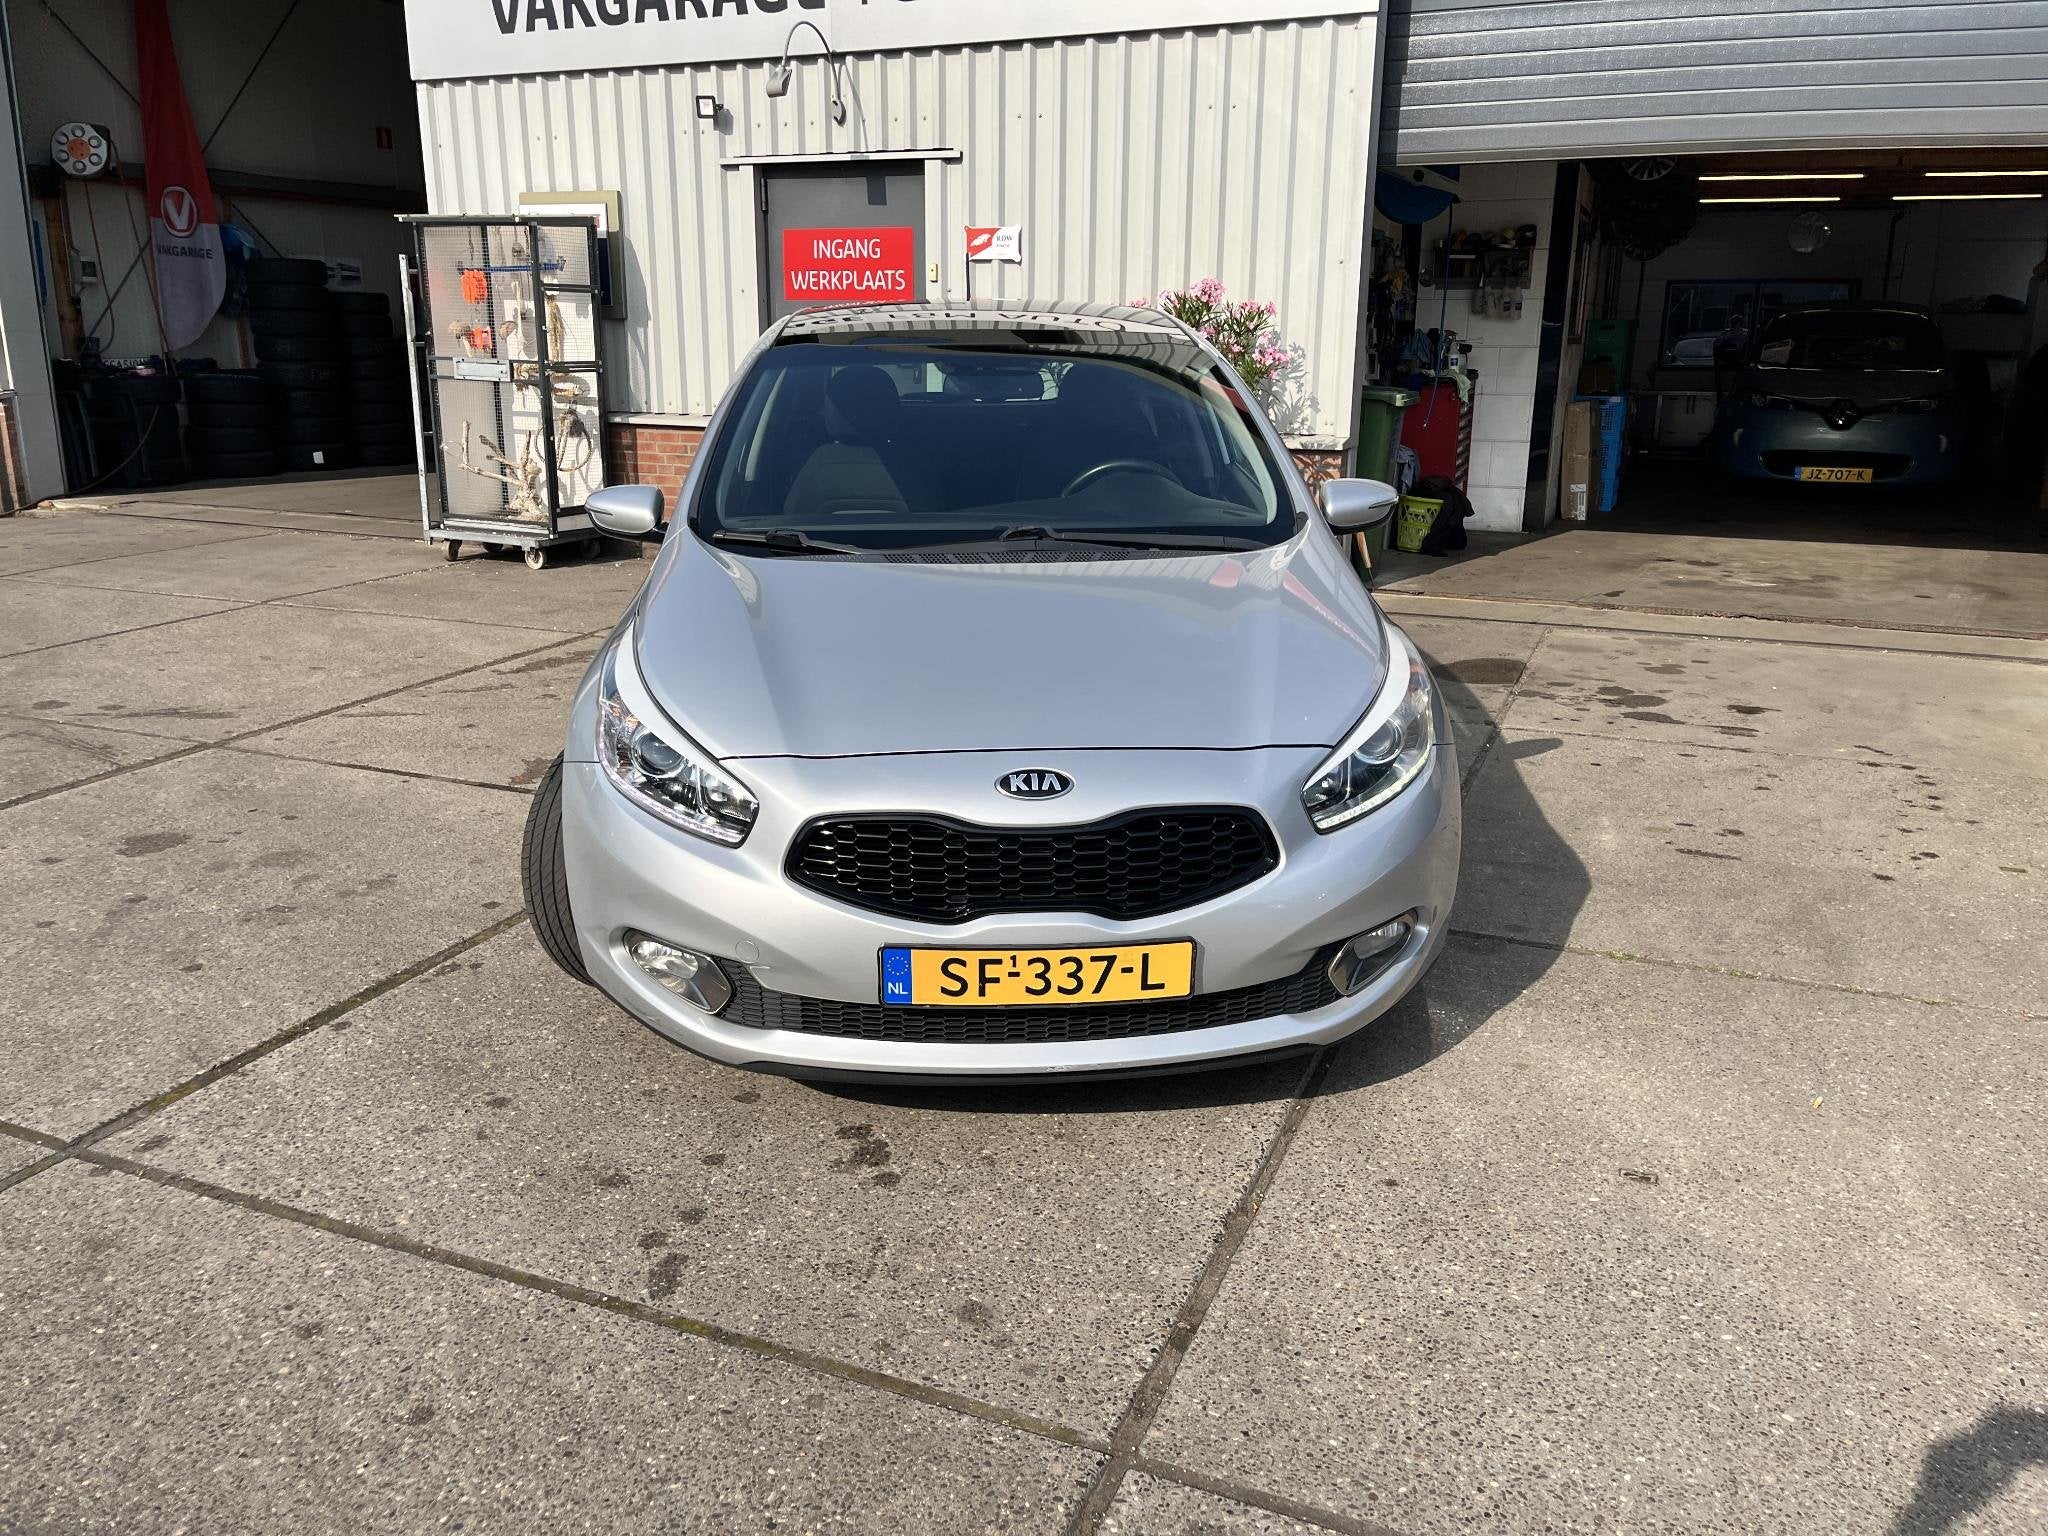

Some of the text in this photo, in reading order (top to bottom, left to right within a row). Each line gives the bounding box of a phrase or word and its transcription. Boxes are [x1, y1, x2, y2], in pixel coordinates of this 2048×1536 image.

[813, 238, 881, 259] INGANG
[791, 270, 906, 291] WERKPLAATS
[1807, 469, 1865, 481] JZ-707-K
[1009, 773, 1062, 792] KIA
[887, 982, 909, 995] NL
